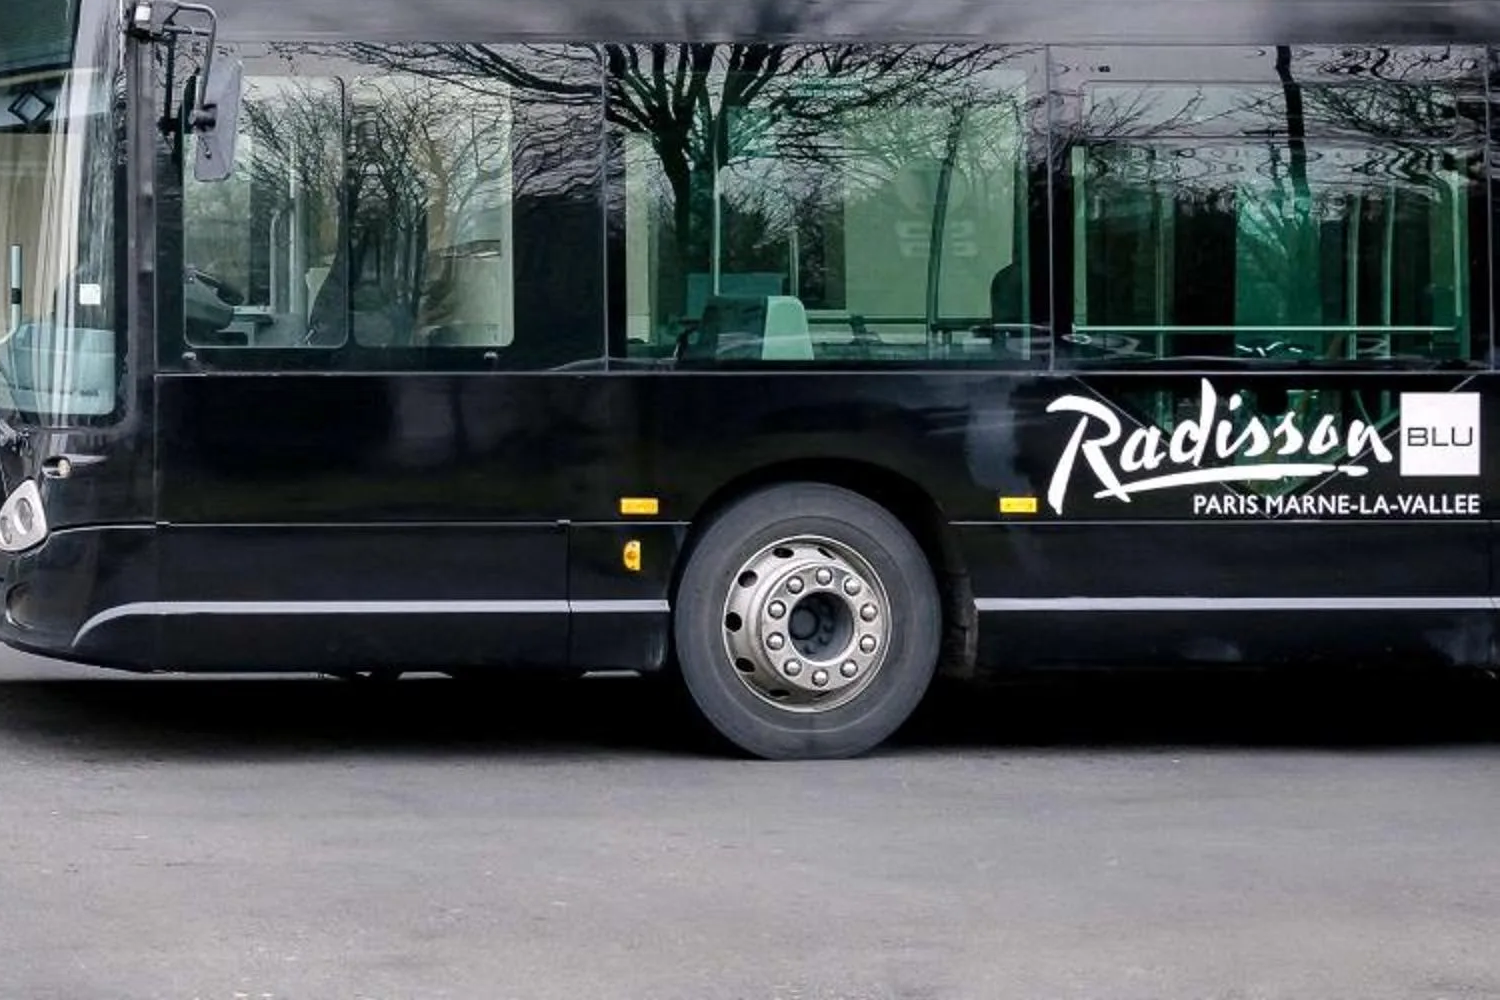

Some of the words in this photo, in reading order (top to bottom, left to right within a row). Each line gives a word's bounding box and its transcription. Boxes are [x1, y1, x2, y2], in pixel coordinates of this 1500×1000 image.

[1046, 377, 1393, 515] Radisson
[1407, 426, 1474, 447] BLU
[1194, 494, 1259, 515] PARIS
[1266, 494, 1480, 514] MARNE-LA-VALLEE
